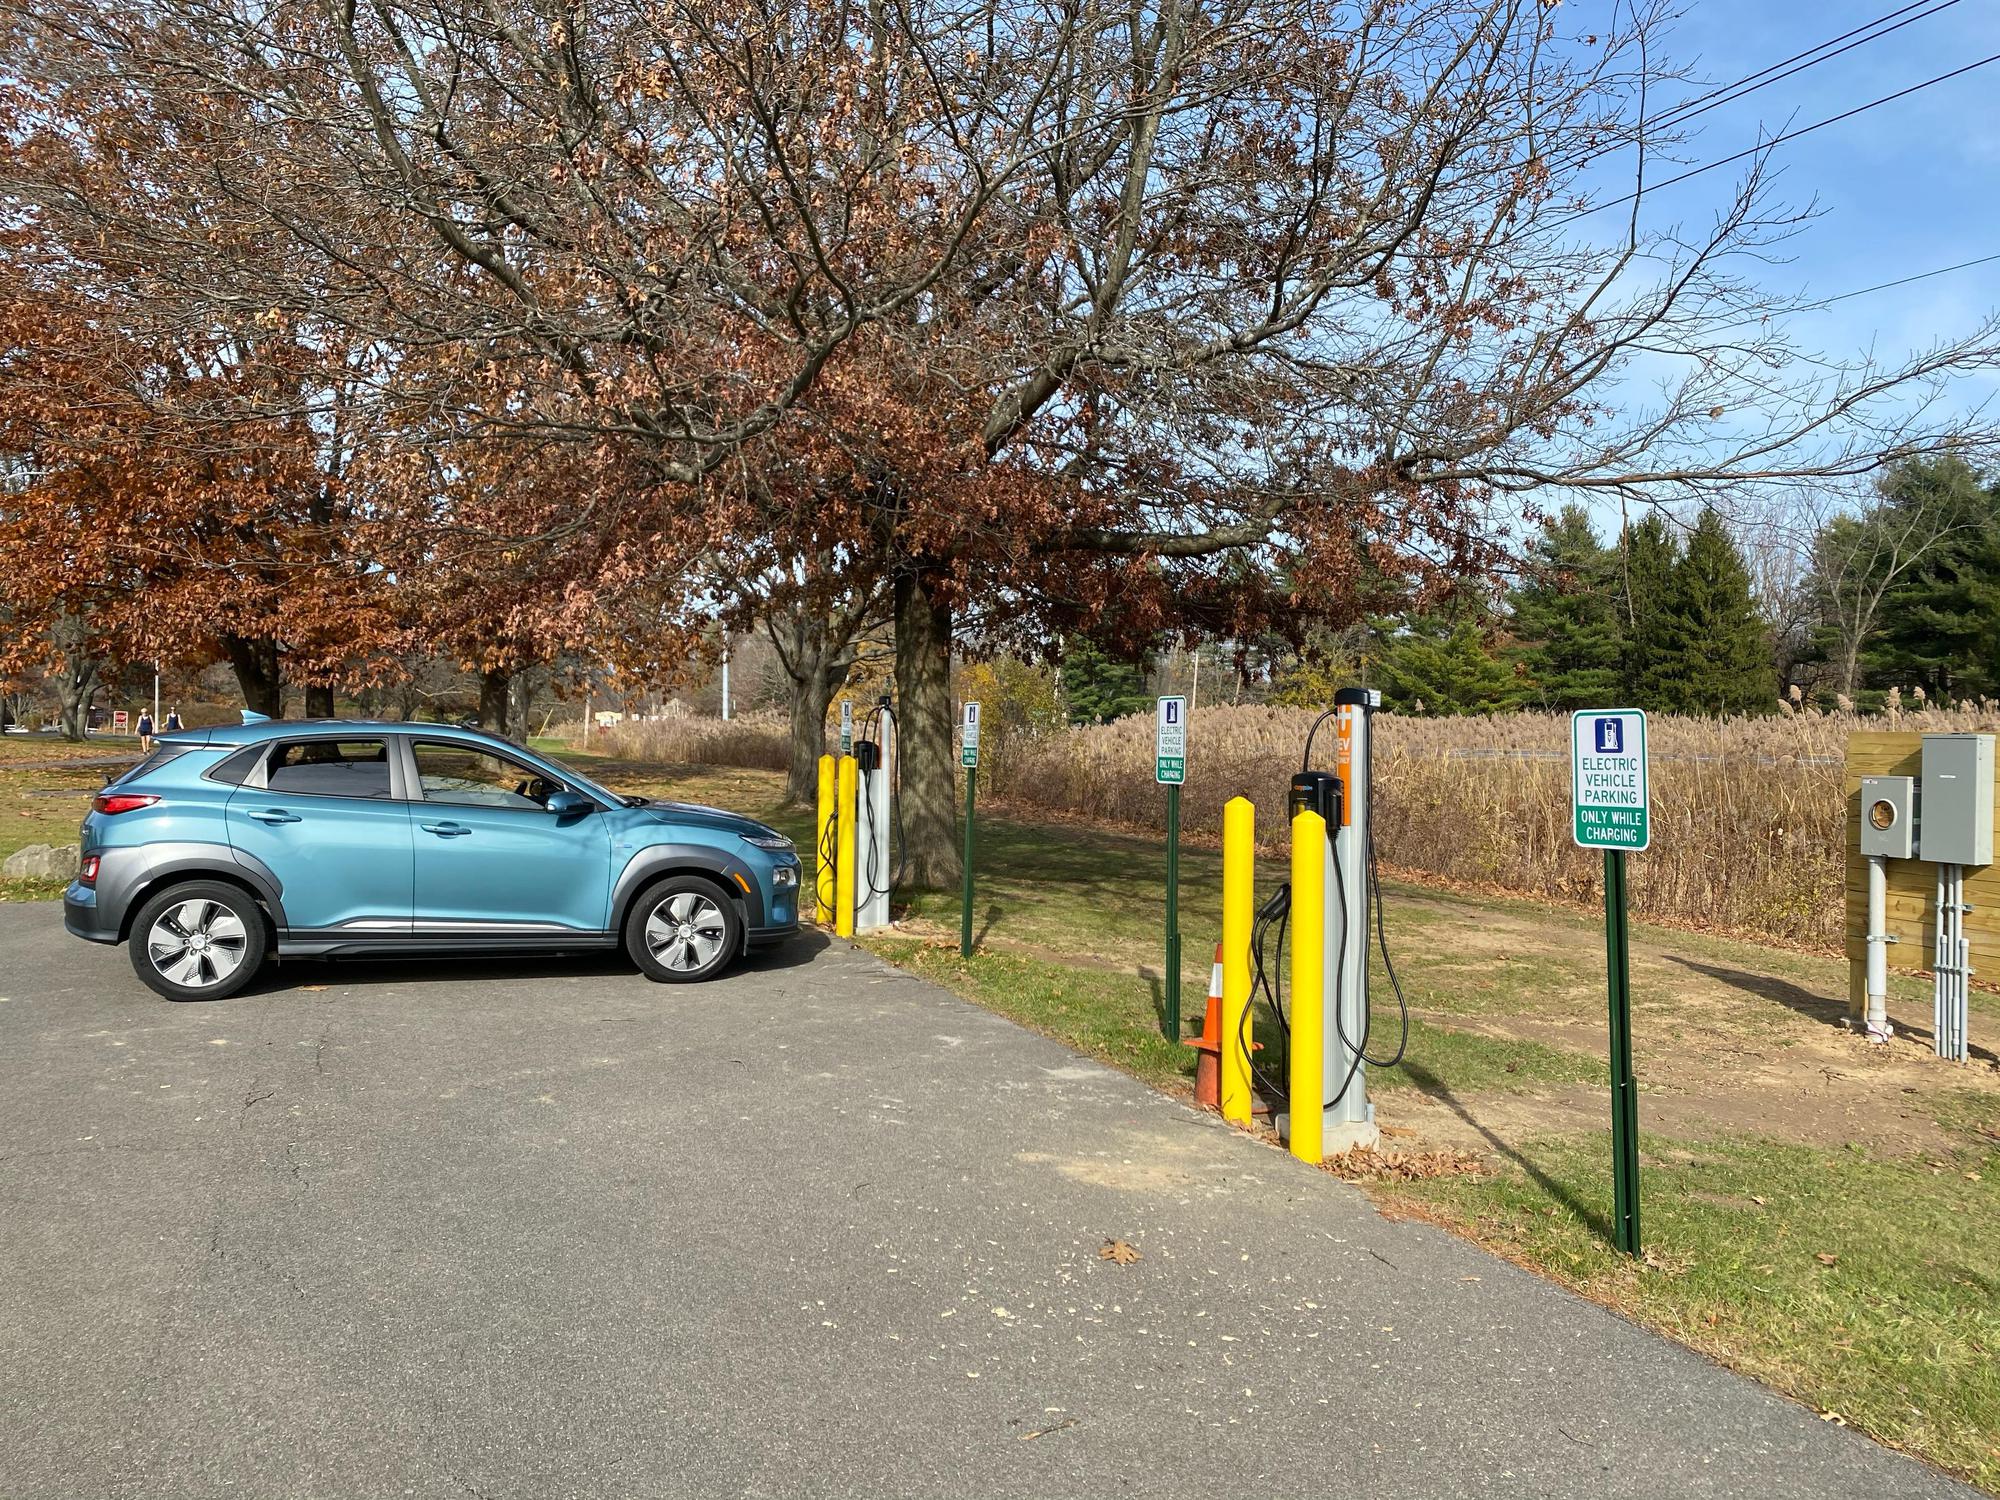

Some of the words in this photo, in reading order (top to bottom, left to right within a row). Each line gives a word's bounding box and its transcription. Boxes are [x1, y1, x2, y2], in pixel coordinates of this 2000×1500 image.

[1161, 726, 1182, 735] ELECTRIC
[1162, 736, 1182, 745] VEHICLE
[1162, 746, 1182, 755] PARKING
[1160, 759, 1170, 769] ONLY
[1171, 760, 1183, 769] WHILE
[1582, 758, 1637, 771] ELECTRIC
[1161, 769, 1181, 779] CHARGING
[1585, 774, 1636, 787] VEHICLE
[1585, 789, 1637, 804] PARKING
[1581, 810, 1608, 824] ONLY
[1611, 811, 1642, 826] WHILE
[1586, 827, 1637, 842] CHARGING
